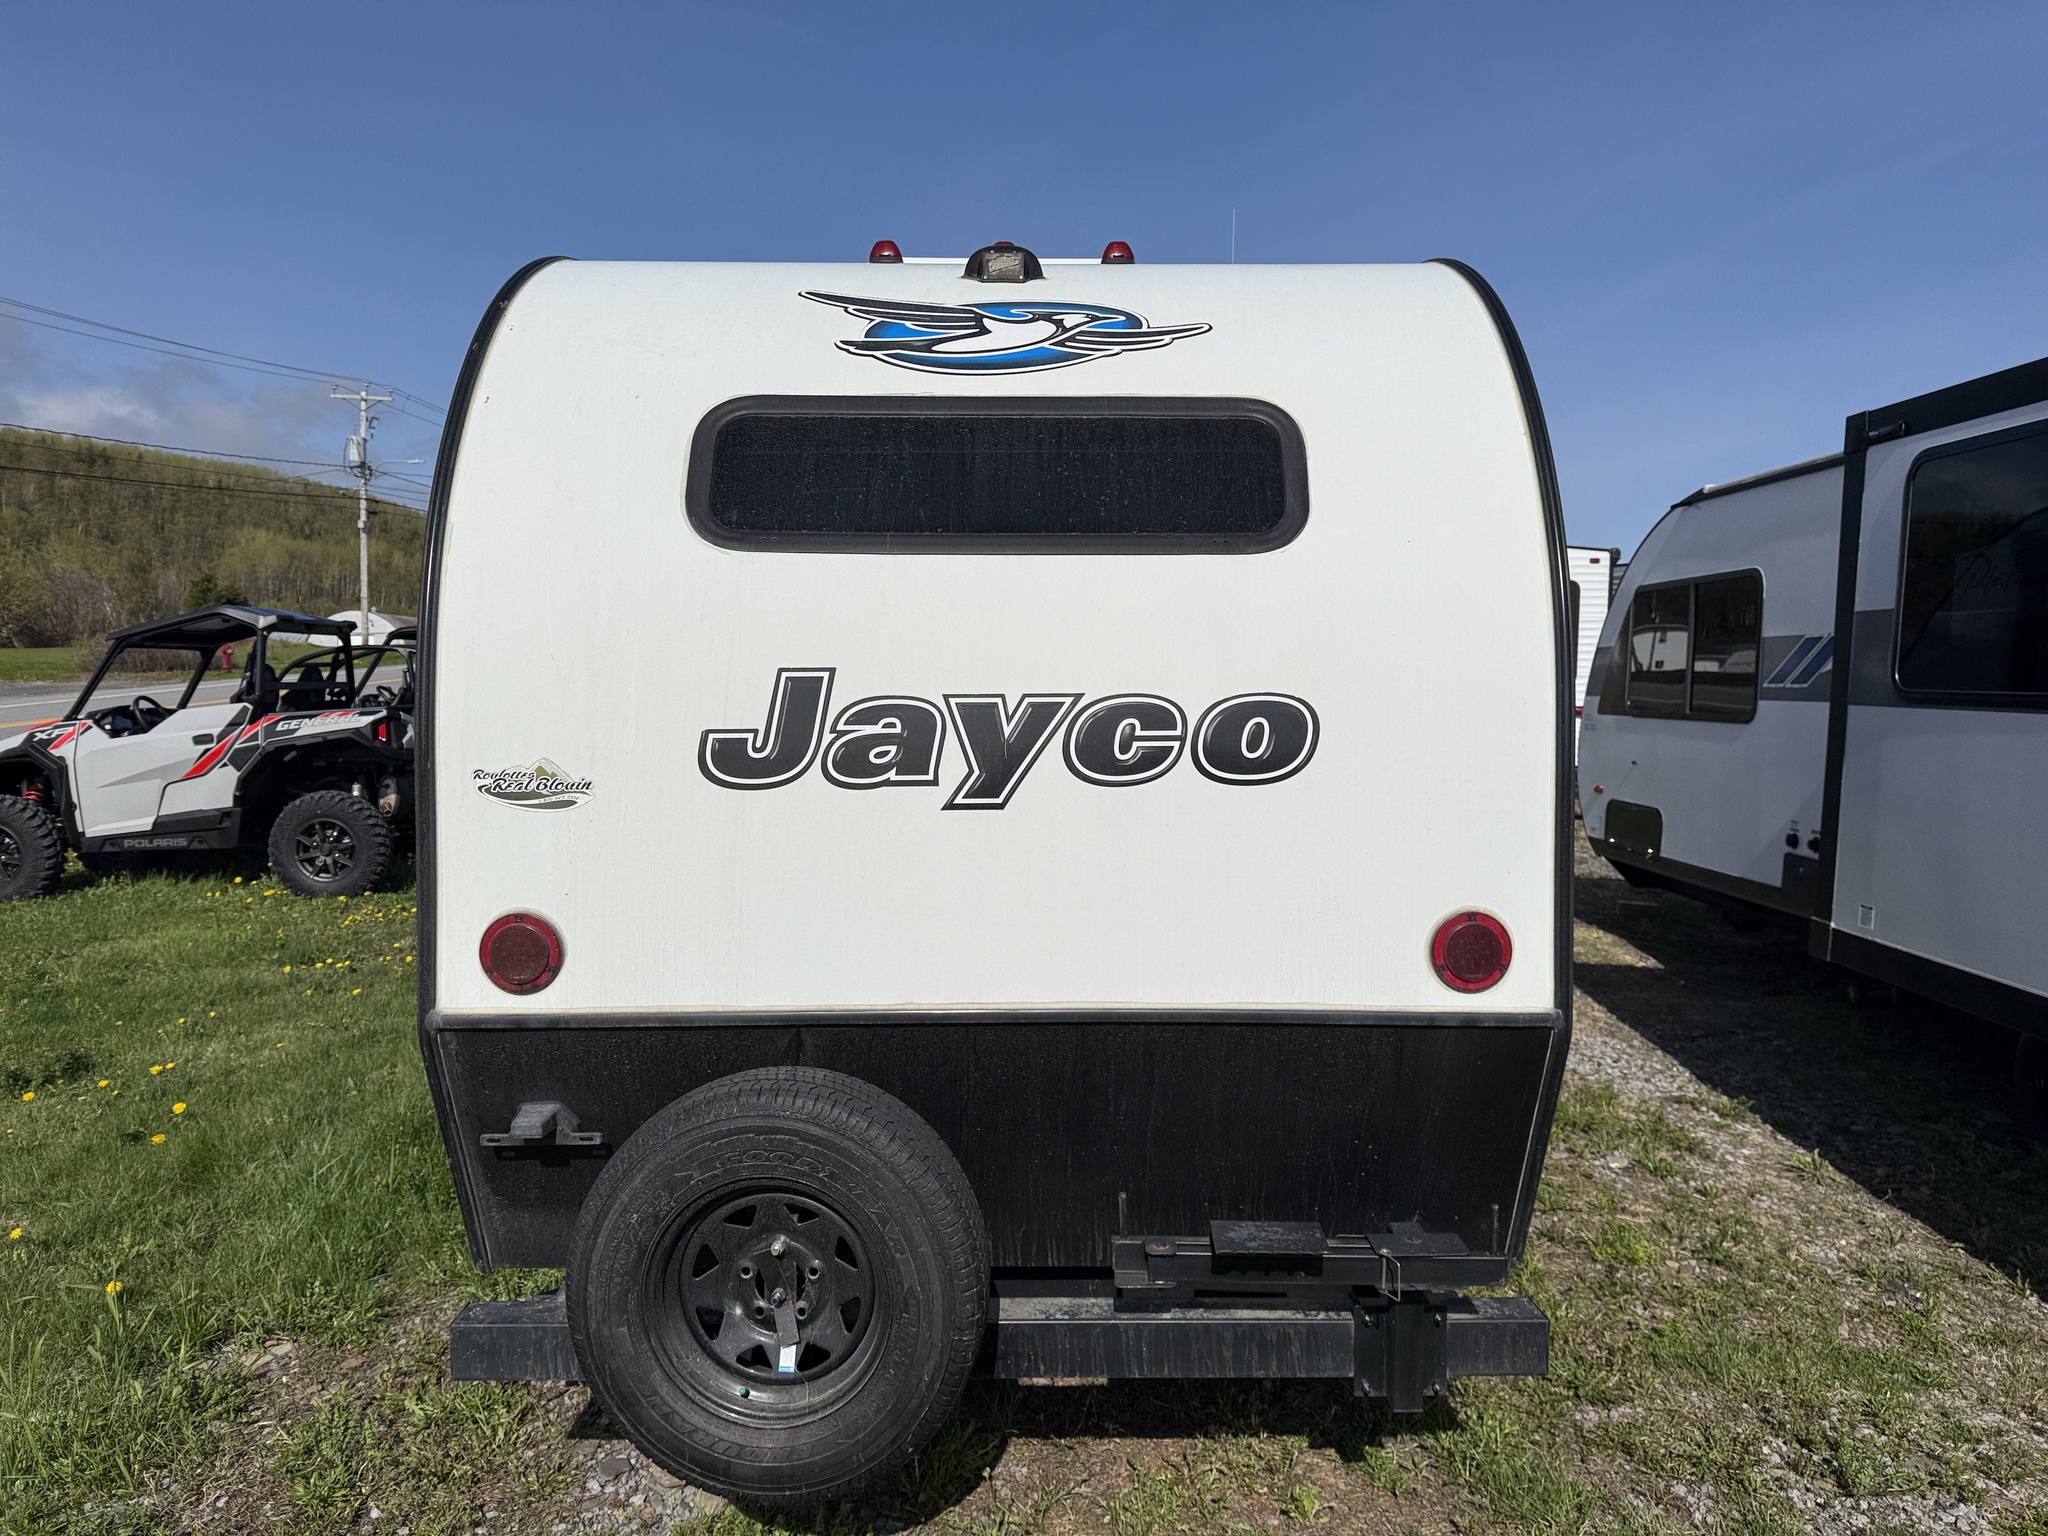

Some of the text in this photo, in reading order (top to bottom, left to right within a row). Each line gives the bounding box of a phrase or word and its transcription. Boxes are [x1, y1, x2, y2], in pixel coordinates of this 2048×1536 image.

[275, 713, 361, 731] GENERAL
[32, 728, 71, 741] XP
[697, 667, 1320, 810] Jayco
[536, 777, 592, 791] Blouin
[123, 837, 188, 848] POLARIS
